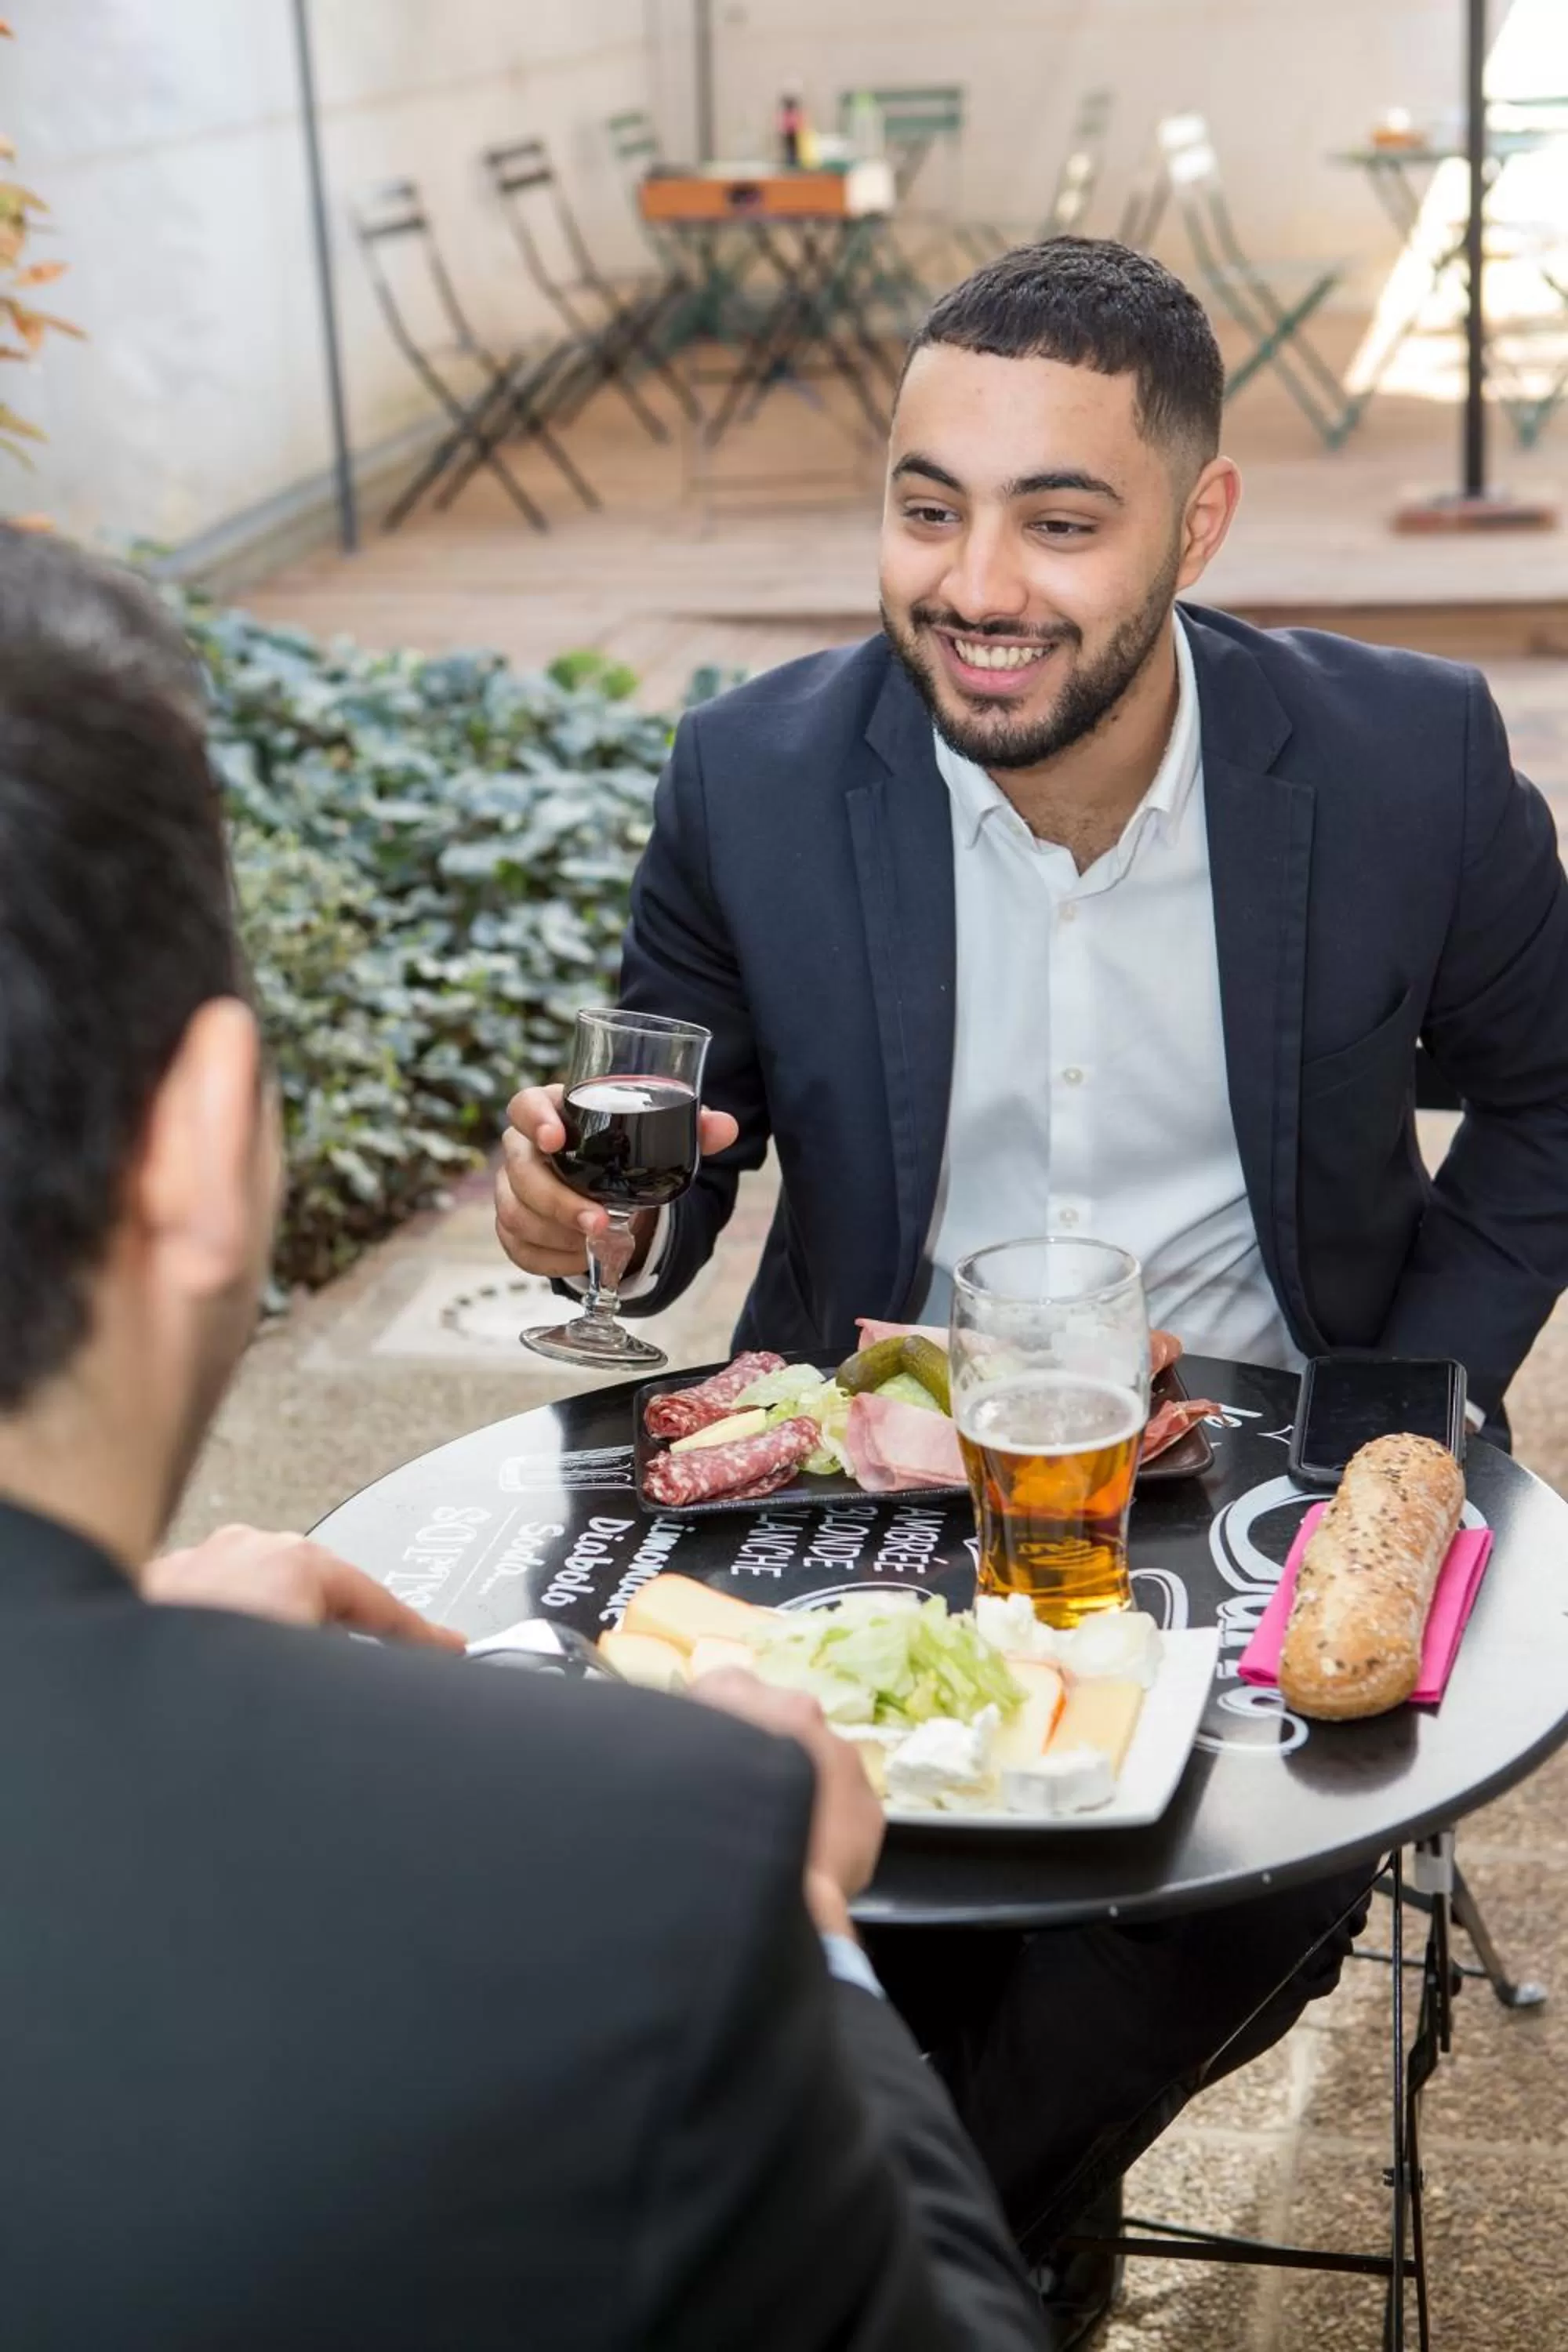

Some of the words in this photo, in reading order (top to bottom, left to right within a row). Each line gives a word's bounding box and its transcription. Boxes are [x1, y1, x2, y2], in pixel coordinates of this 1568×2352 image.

[540, 1515, 636, 1607] Diabolo
[598, 1516, 696, 1621] imonade
[731, 1510, 808, 1578] LANCHE
[873, 1505, 949, 1574] AMBRÉE
